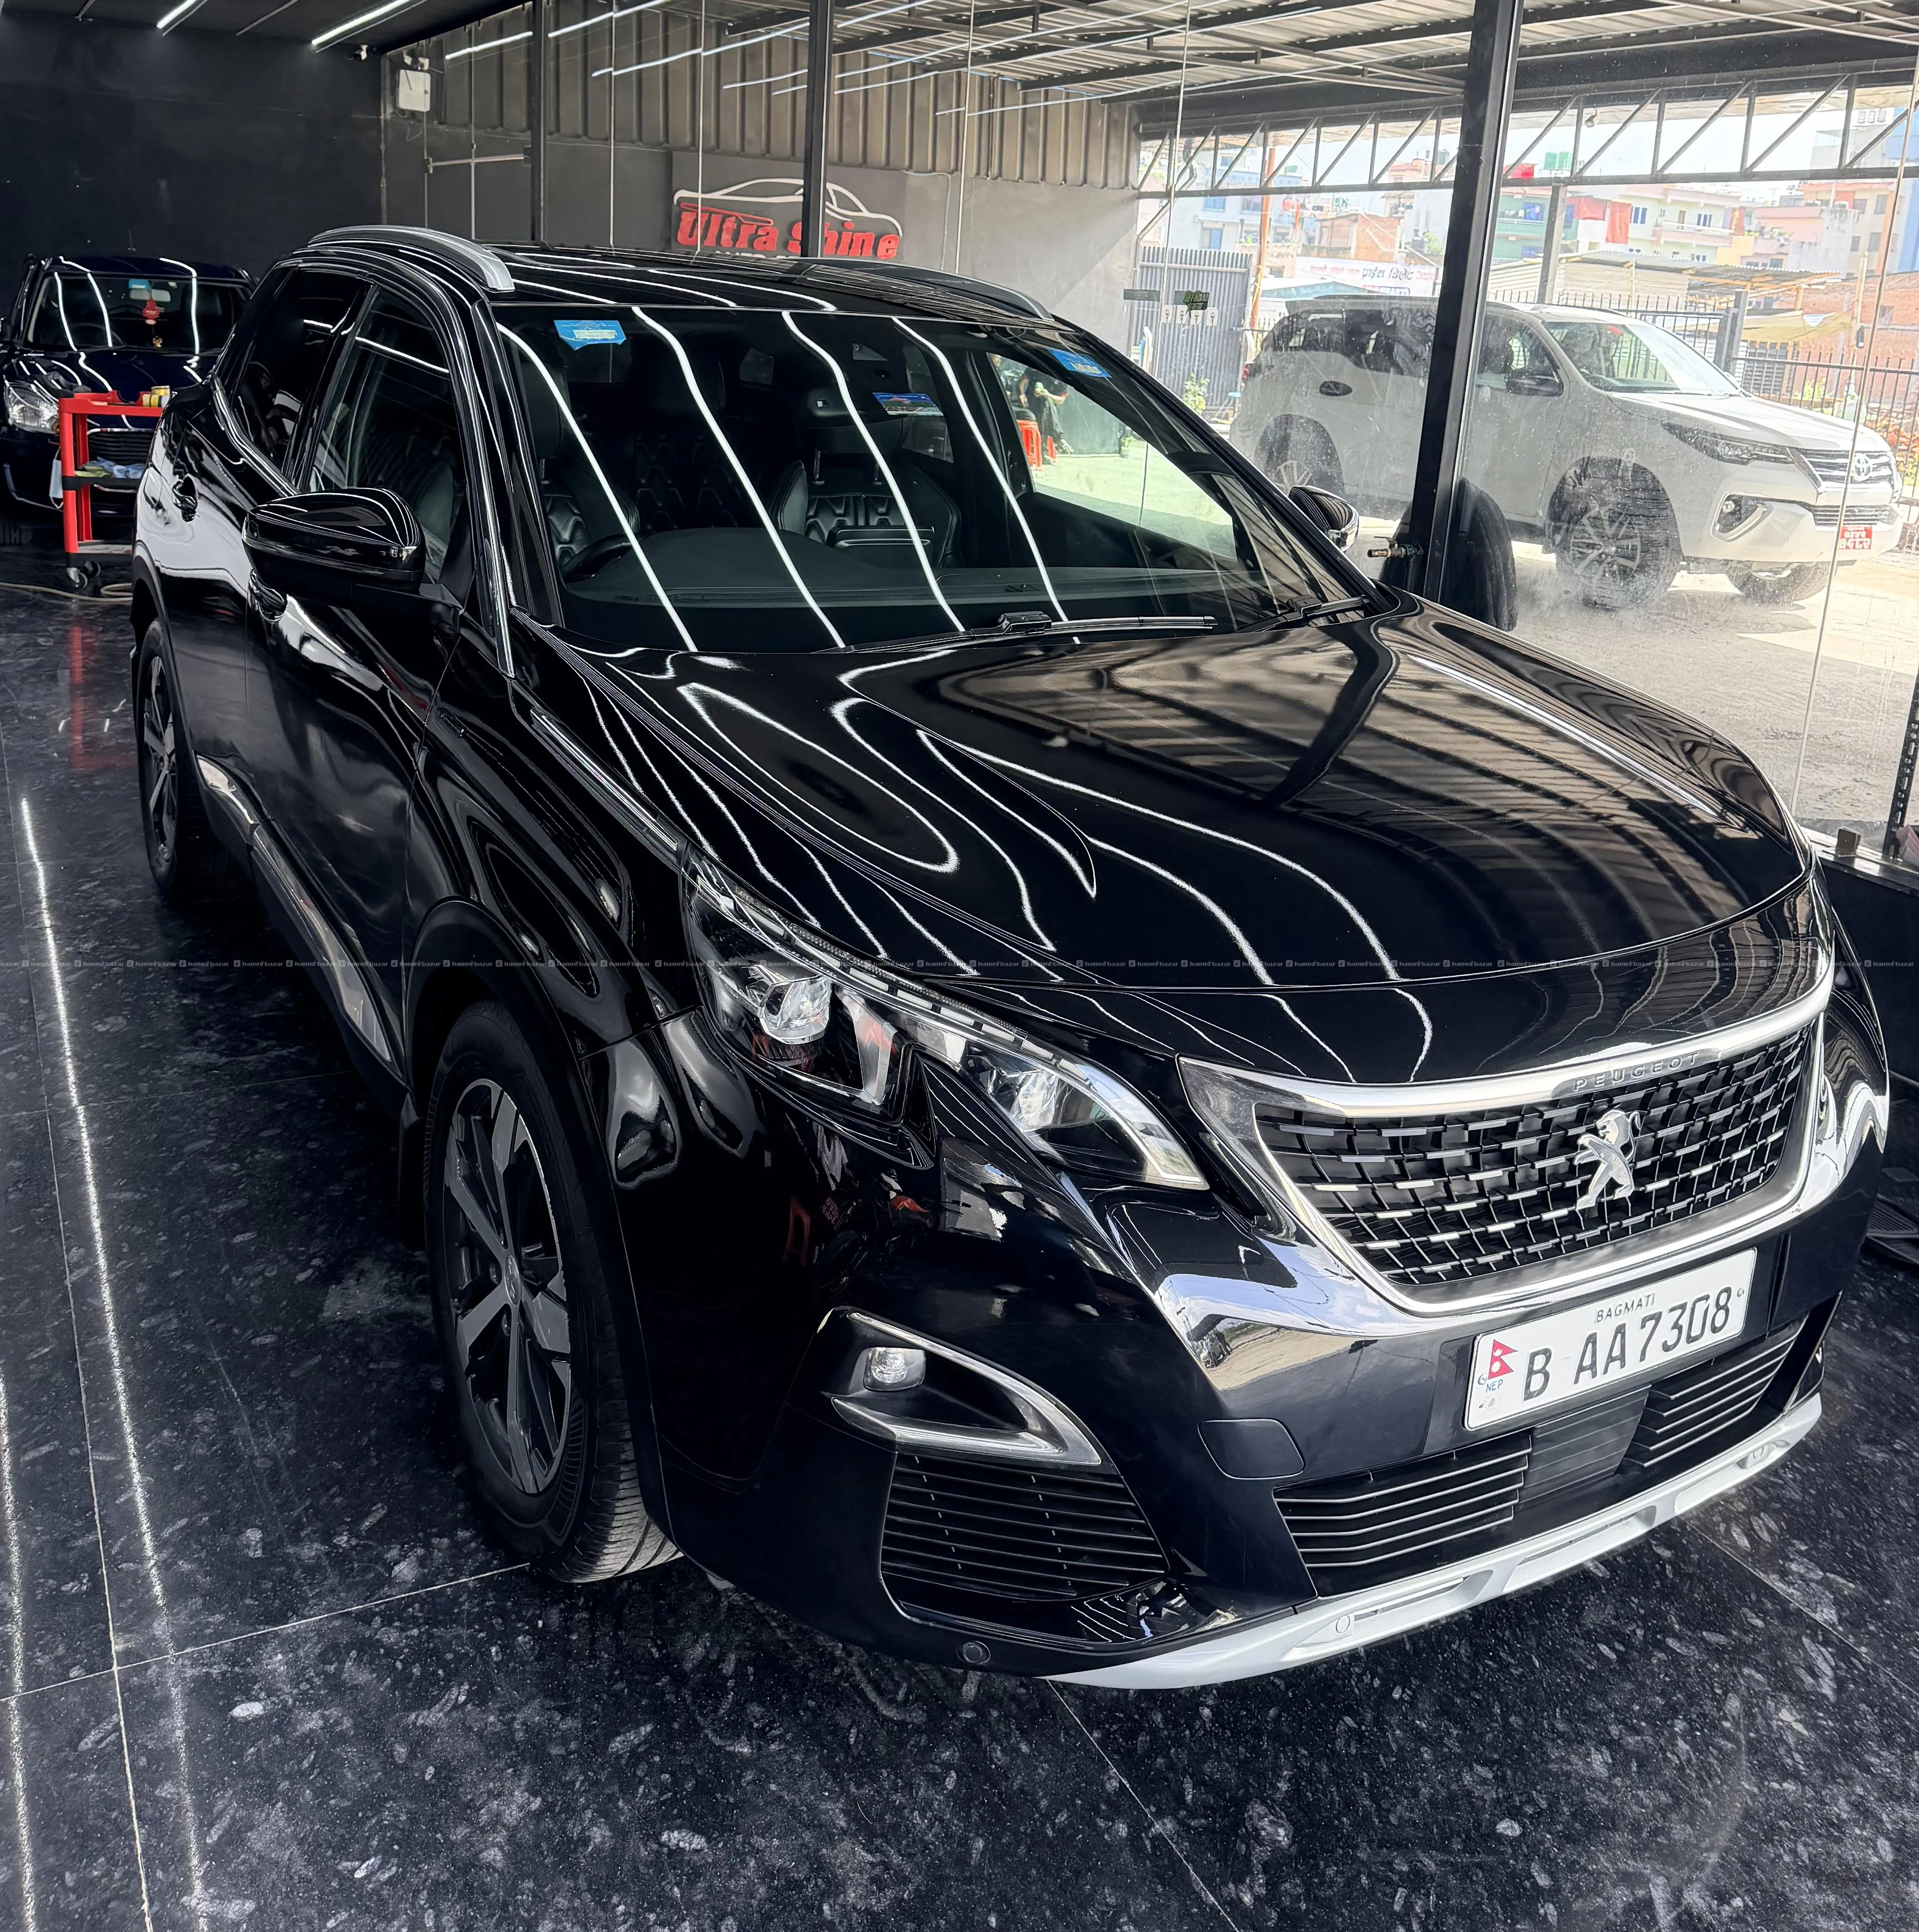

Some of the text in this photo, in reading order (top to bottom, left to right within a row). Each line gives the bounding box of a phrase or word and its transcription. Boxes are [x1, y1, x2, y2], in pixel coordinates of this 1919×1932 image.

[677, 211, 779, 251] Ultra
[1574, 1052, 1699, 1091] PEUGEOT
[1595, 1293, 1656, 1323] BAGMATI
[1486, 1379, 1503, 1393] NEP
[1523, 1346, 1553, 1401] B
